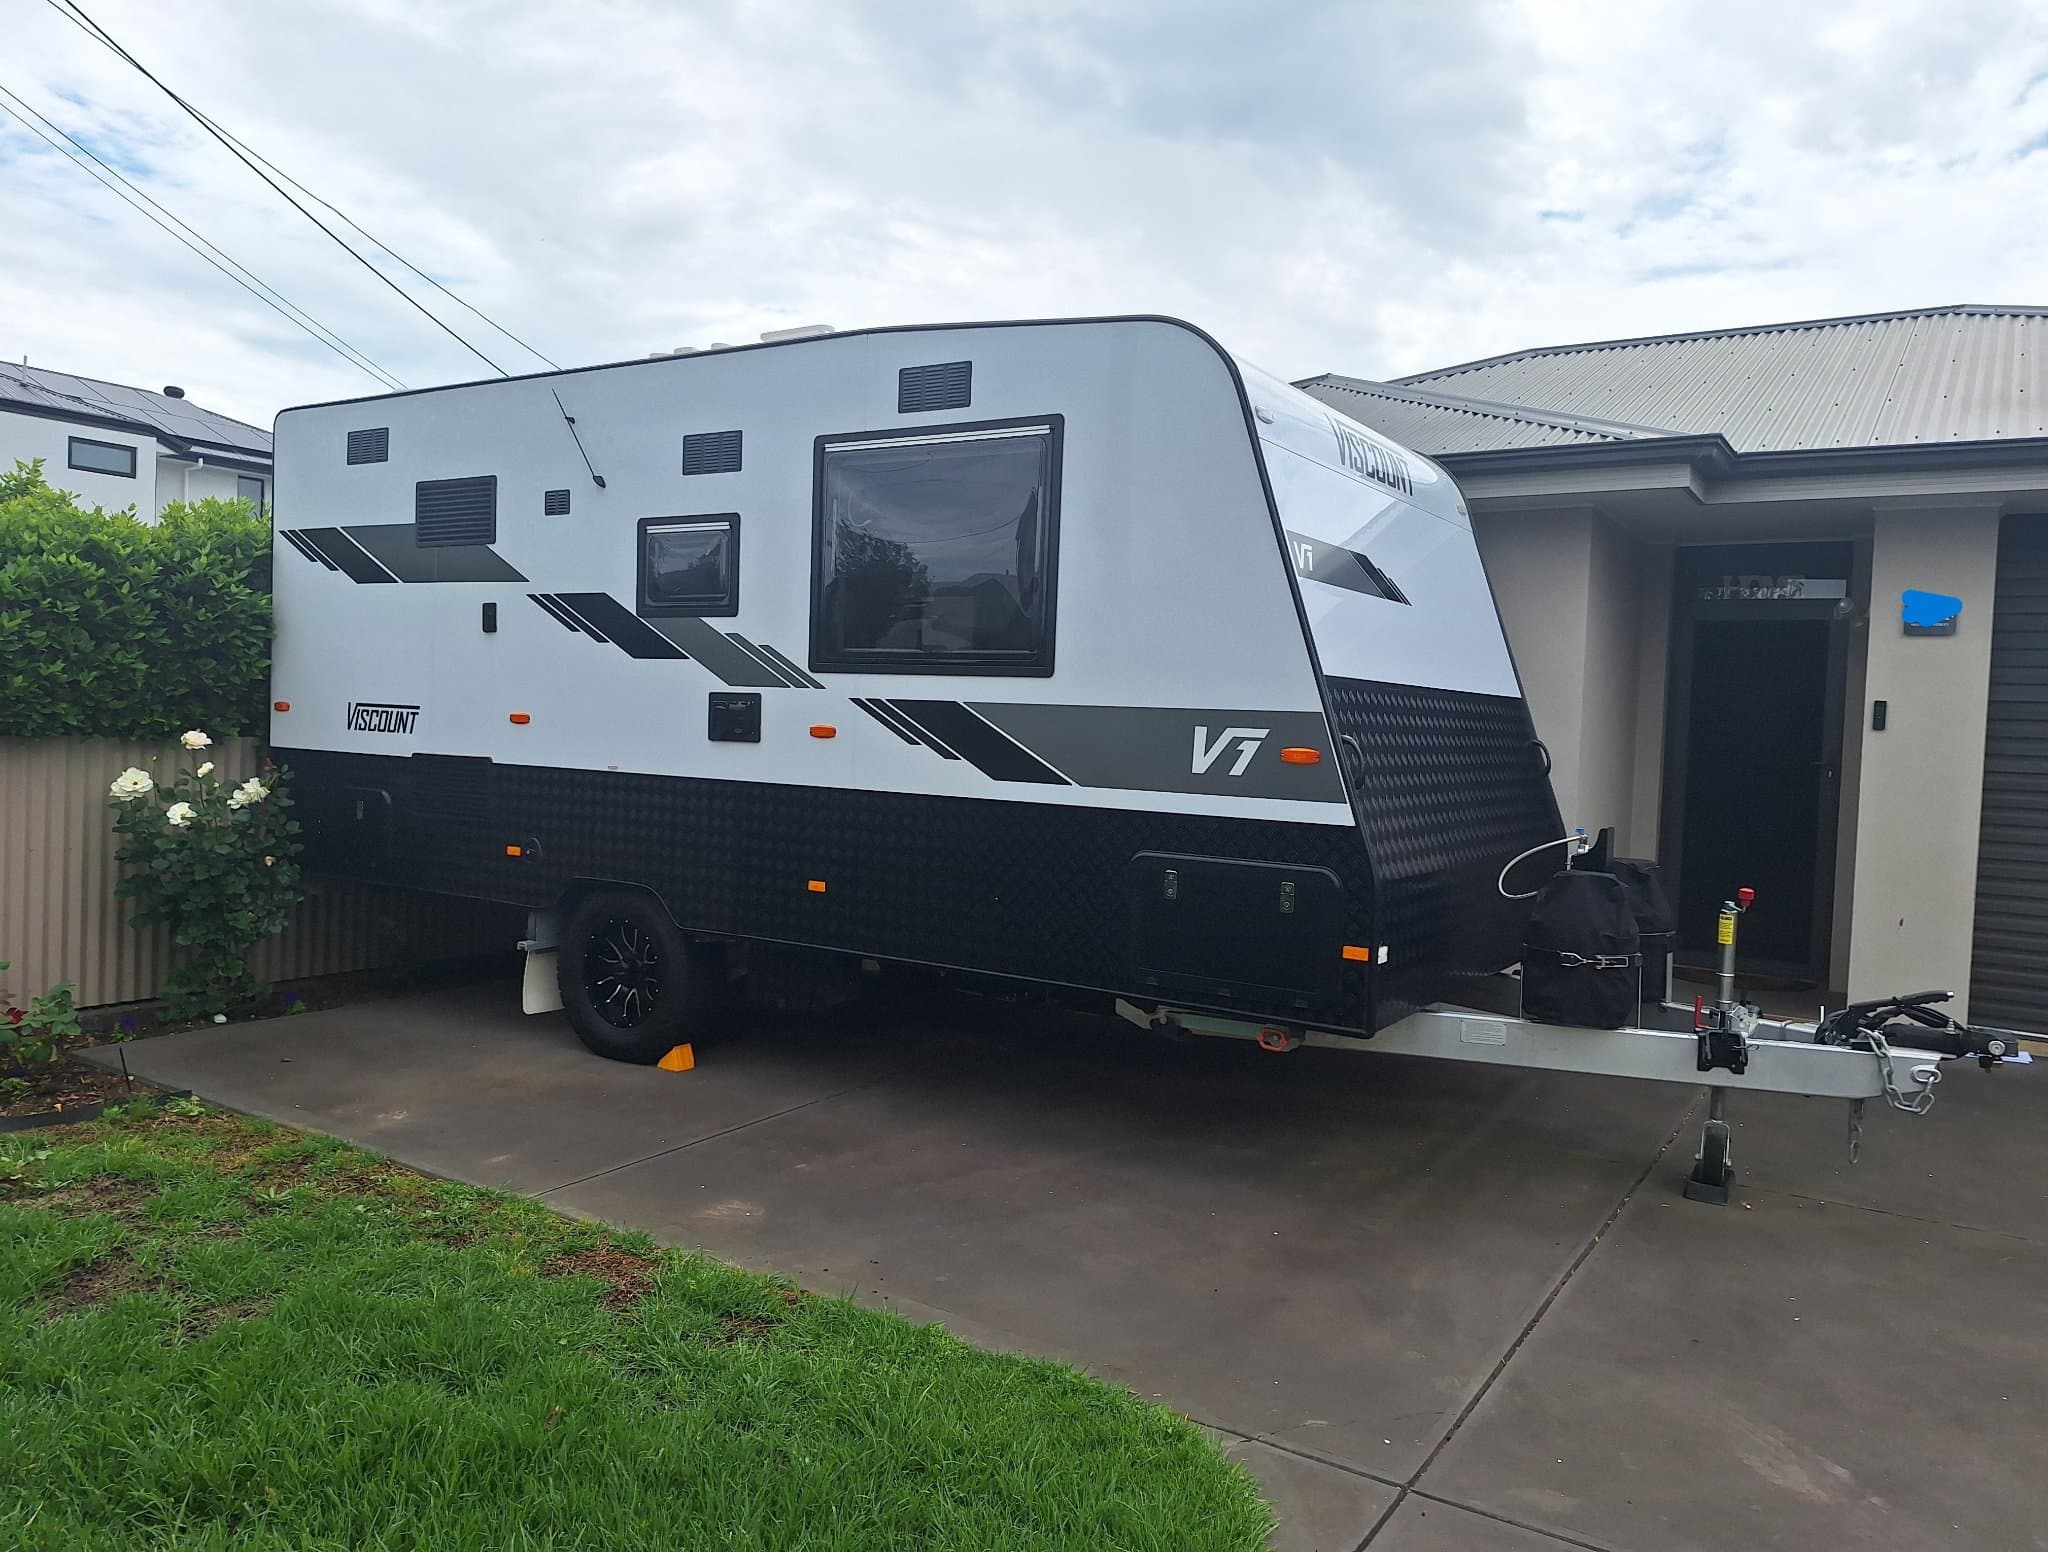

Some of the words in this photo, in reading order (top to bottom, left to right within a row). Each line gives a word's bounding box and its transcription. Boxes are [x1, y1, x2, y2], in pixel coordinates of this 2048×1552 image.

[1323, 412, 1413, 496] VISCOUNT
[1293, 541, 1313, 571] V1
[347, 702, 420, 734] VISCOUNT
[1191, 726, 1271, 776] V1
